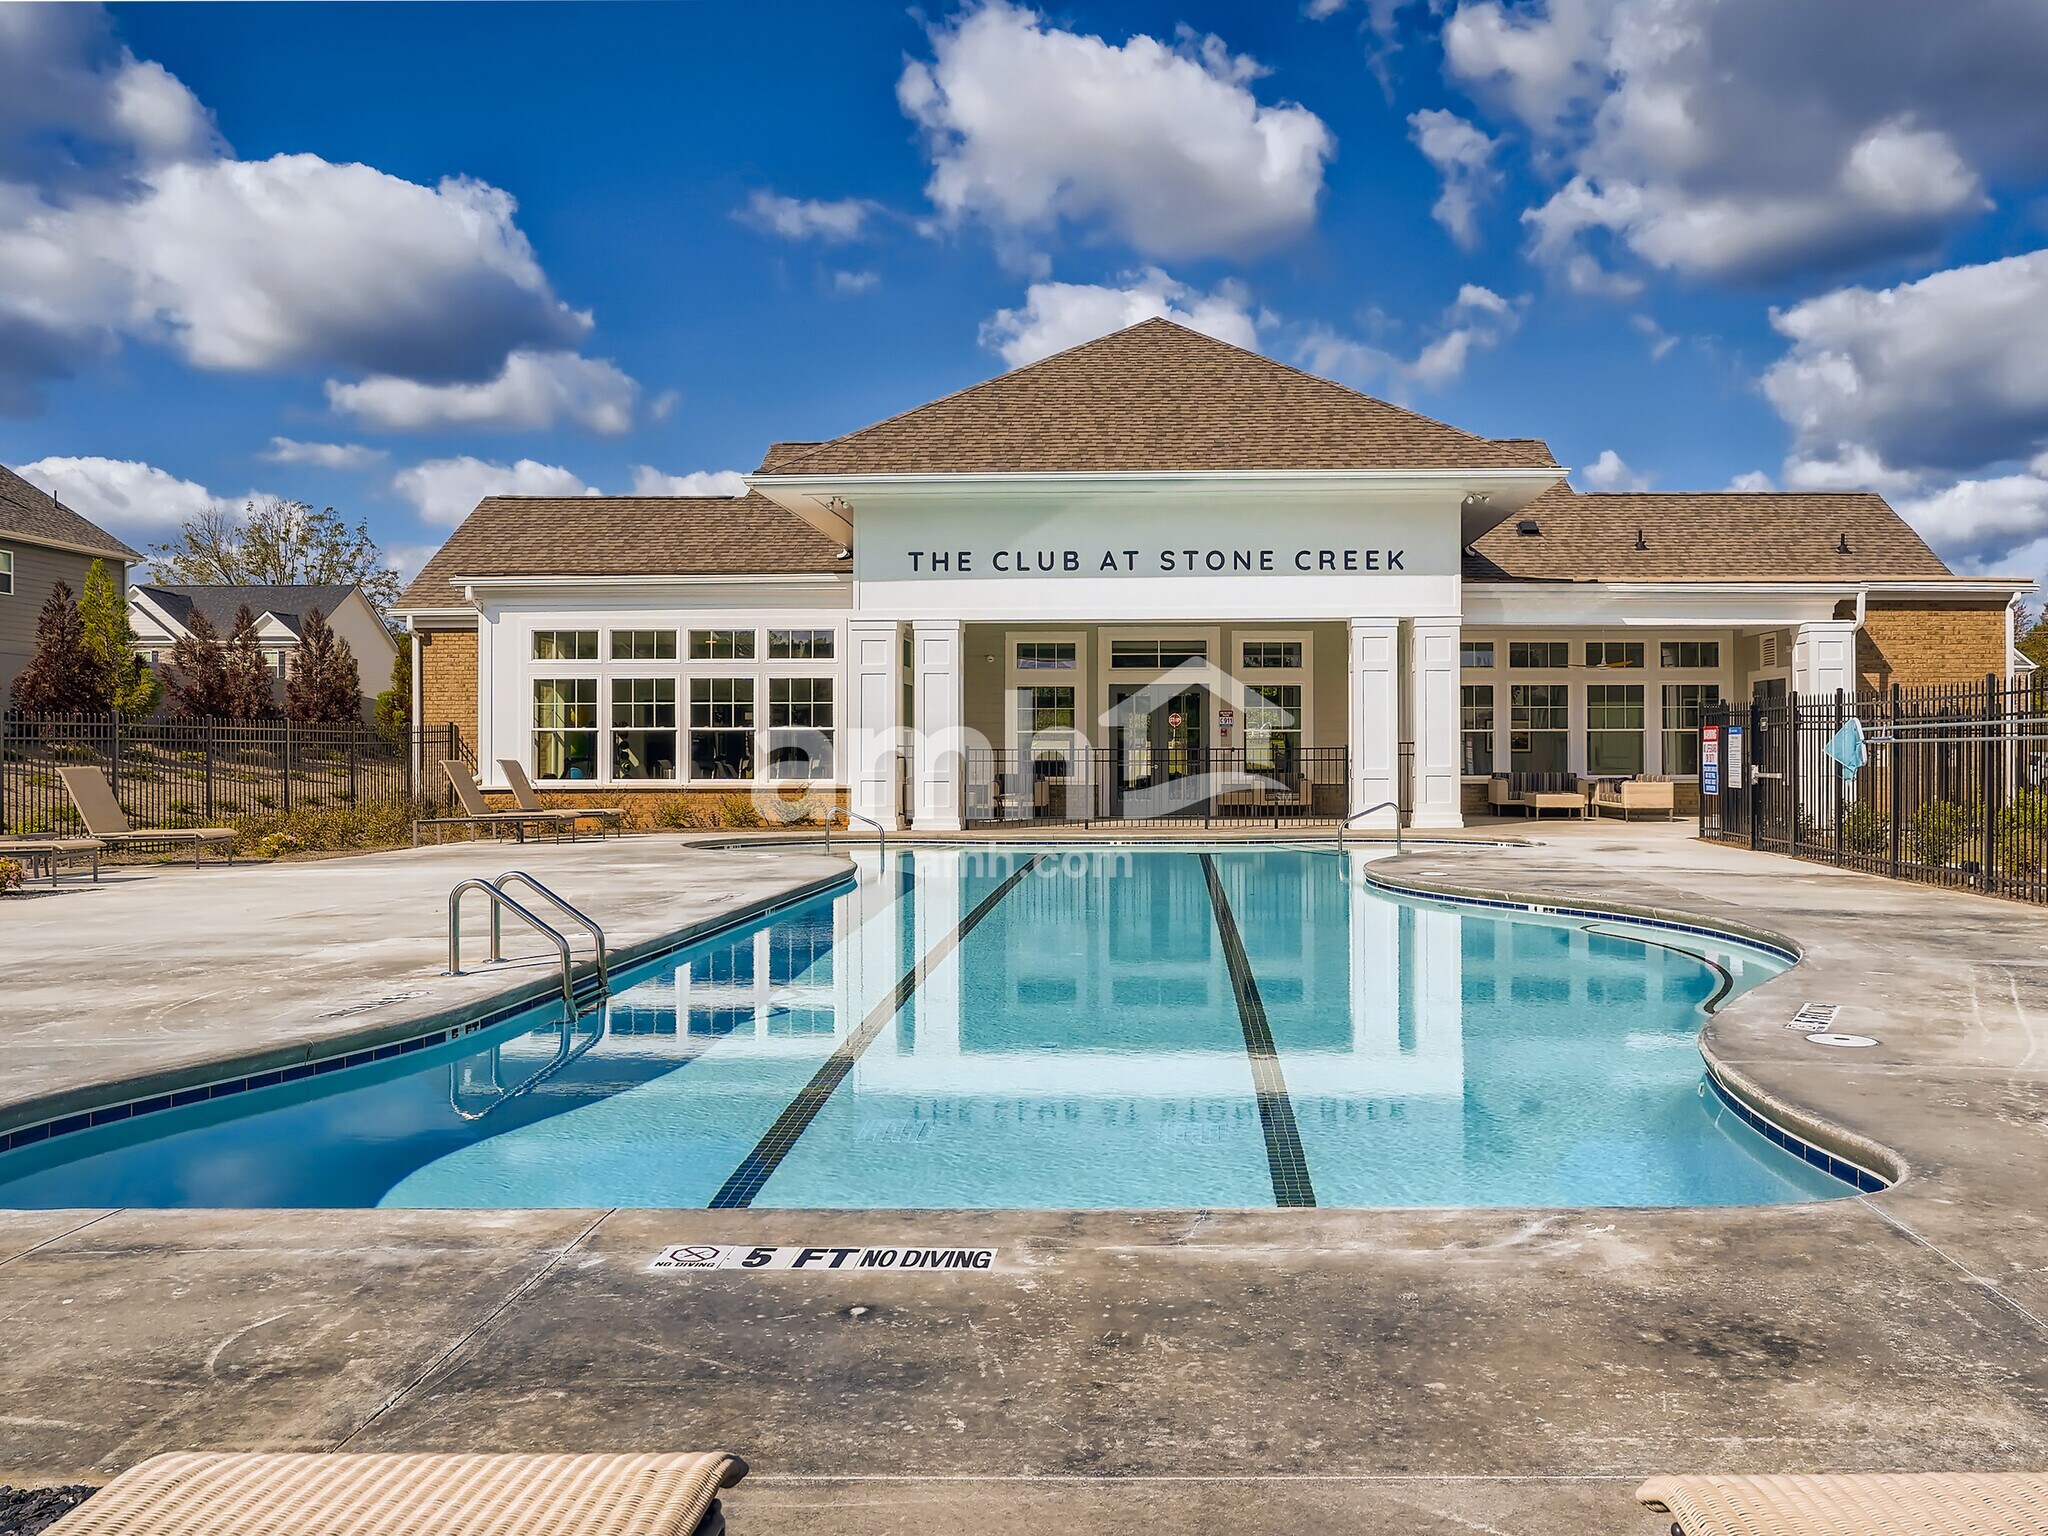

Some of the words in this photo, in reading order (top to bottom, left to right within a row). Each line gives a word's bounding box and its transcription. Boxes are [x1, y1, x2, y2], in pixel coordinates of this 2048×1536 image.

[907, 551, 972, 572] THE
[992, 550, 1080, 572] CLUB
[1099, 550, 1139, 571] AT
[1159, 550, 1274, 571] STONE
[1294, 549, 1405, 571] CREEK
[465, 1020, 480, 1035] FT
[741, 1247, 778, 1268] 5
[791, 1248, 862, 1269] FT
[859, 1250, 898, 1268] NO
[899, 1250, 992, 1269] DIVING
